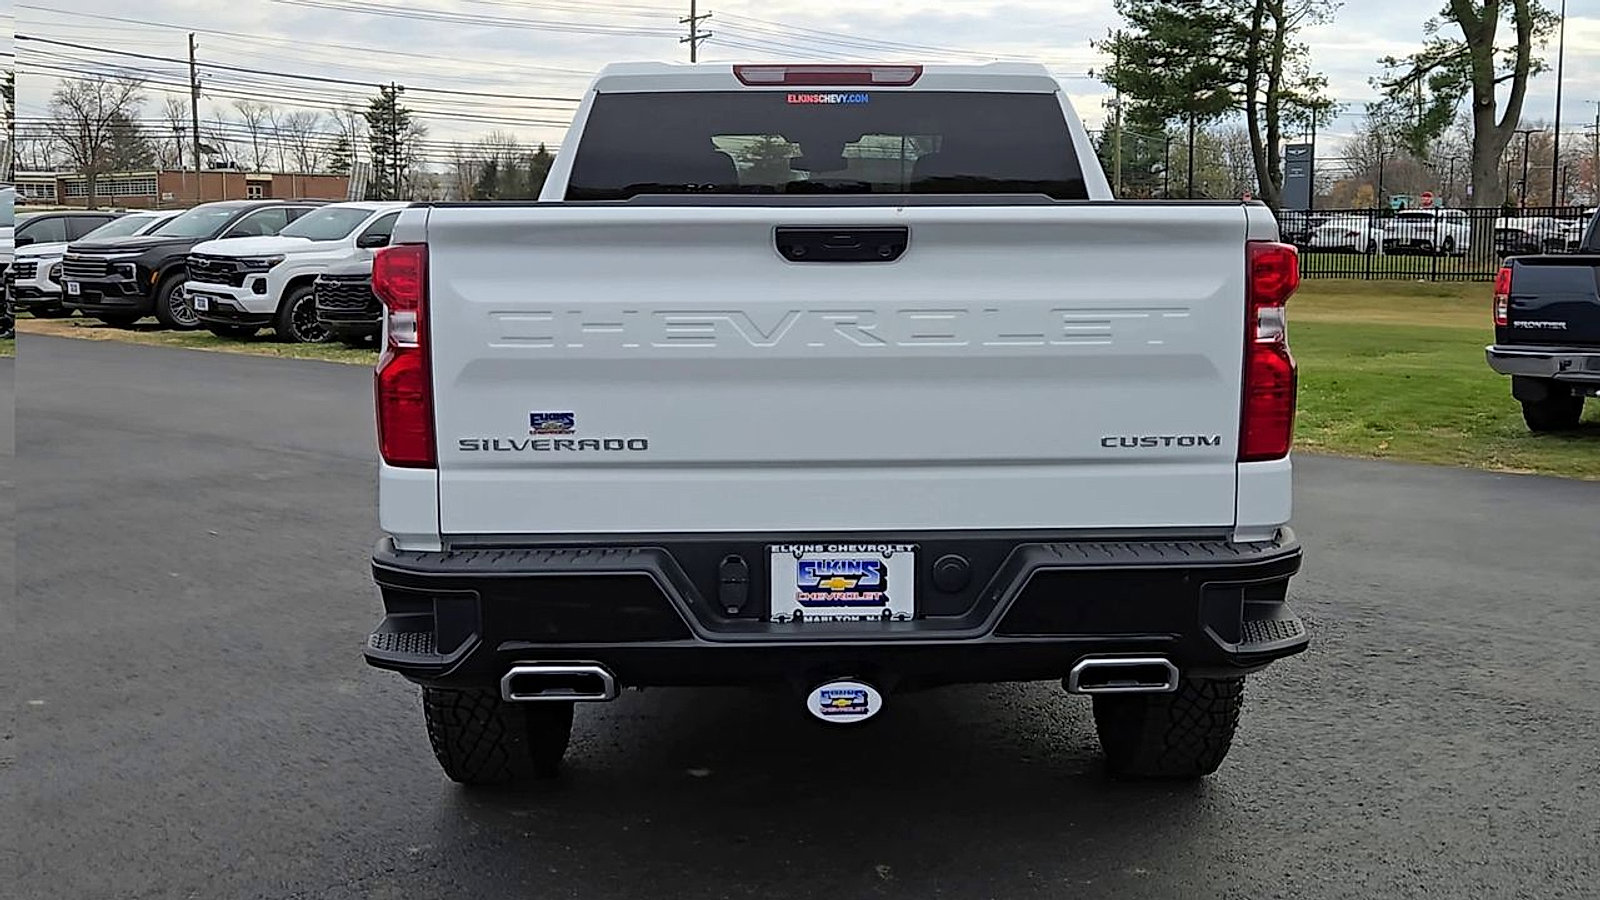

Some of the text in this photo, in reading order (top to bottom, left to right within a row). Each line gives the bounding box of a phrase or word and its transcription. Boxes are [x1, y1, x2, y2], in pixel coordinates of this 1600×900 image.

[787, 93, 869, 104] ELKINSCHEVY.COM
[487, 307, 1191, 348] CHEVROLET
[1513, 320, 1567, 330] FRONTIER
[458, 438, 649, 451] SILVERADO
[1100, 435, 1222, 448] CUSTOM
[771, 544, 915, 552] ELKINS CHEVROLET
[797, 558, 882, 586] ELKINS
[795, 591, 884, 602] CHEVROLET
